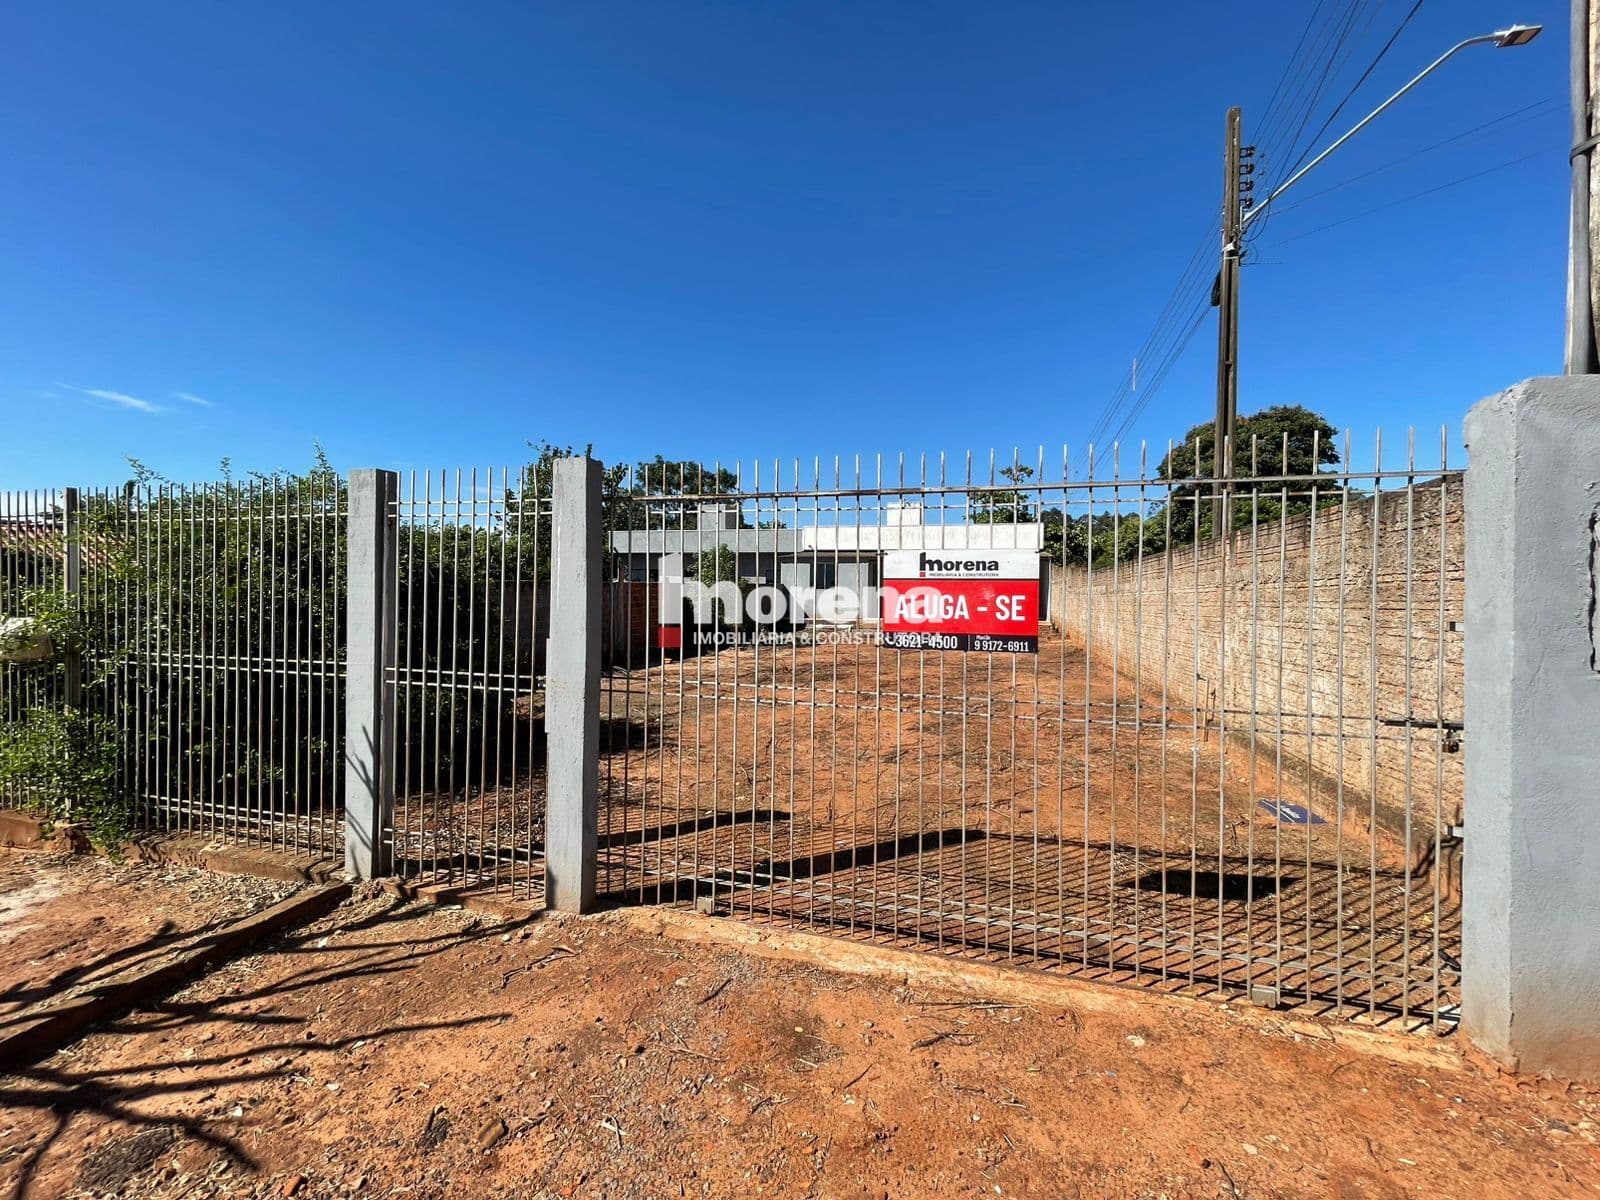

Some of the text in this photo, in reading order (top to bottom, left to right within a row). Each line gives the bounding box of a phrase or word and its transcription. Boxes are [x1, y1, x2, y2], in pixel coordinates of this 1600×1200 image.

[894, 594, 969, 620] ALUGA
[995, 594, 1026, 621] SE
[895, 634, 958, 649] 3621-4500
[974, 640, 1029, 652] 9 9172-6911
